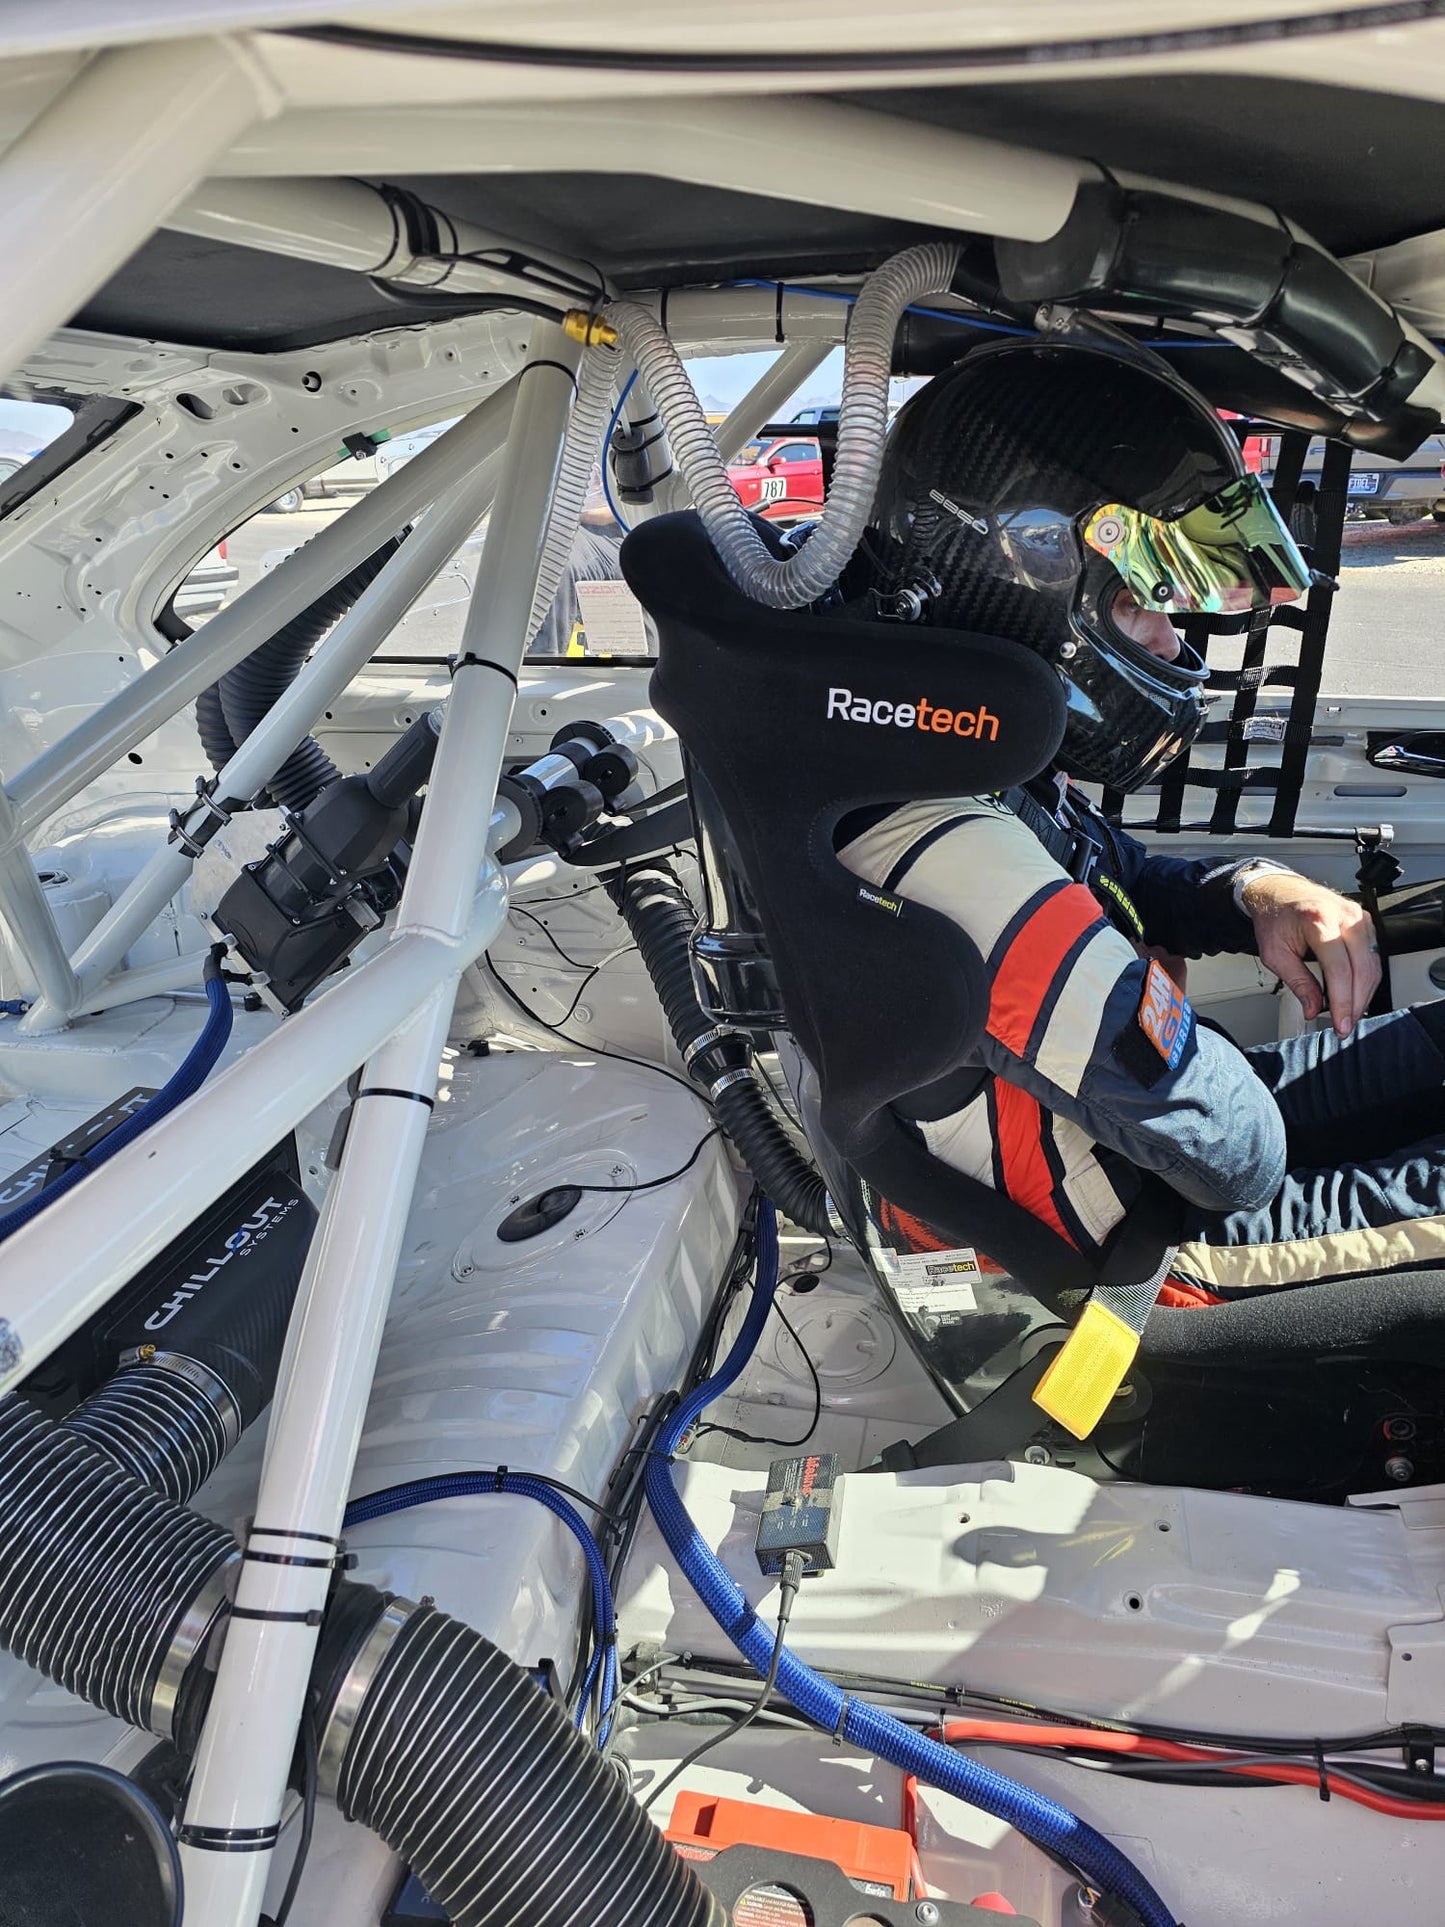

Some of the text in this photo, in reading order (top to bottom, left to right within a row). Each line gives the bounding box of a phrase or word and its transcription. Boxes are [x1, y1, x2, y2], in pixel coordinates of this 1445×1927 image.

[764, 480, 784, 498] 787
[827, 687, 999, 741] Racetech
[859, 888, 897, 911] Racetech
[1143, 965, 1171, 1039] 24H
[239, 1199, 299, 1256] SYSTEMS
[144, 1196, 283, 1330] CHILLOUT
